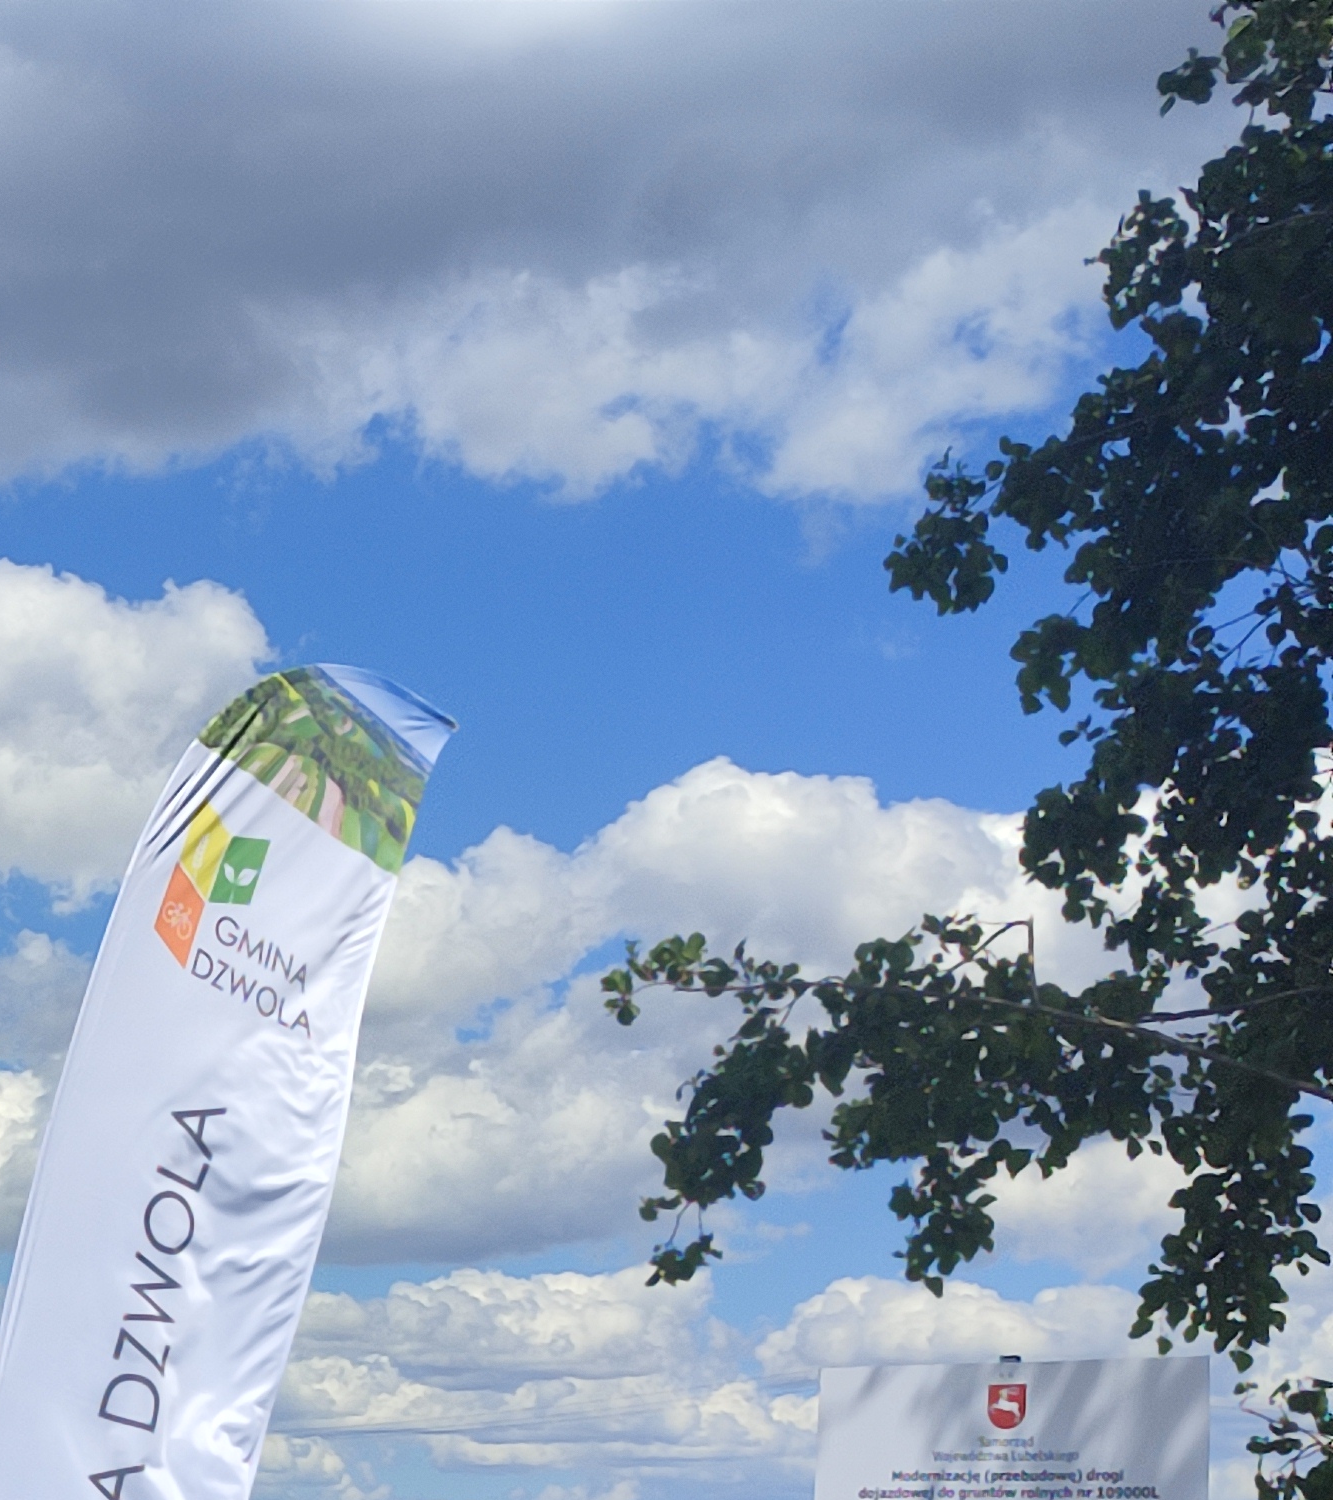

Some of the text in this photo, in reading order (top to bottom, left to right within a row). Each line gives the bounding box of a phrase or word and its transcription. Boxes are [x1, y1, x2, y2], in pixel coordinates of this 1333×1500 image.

[191, 947, 312, 1039] DZWOLA
[214, 915, 308, 994] GMINA
[98, 1107, 227, 1434] DZWOLA
[858, 1485, 935, 1500] dojazdowej
[937, 1486, 955, 1499] do
[958, 1486, 1017, 1500] gruntów
[1021, 1486, 1073, 1500] rolnych
[1076, 1488, 1093, 1499] nr
[1086, 1468, 1124, 1484] drogi
